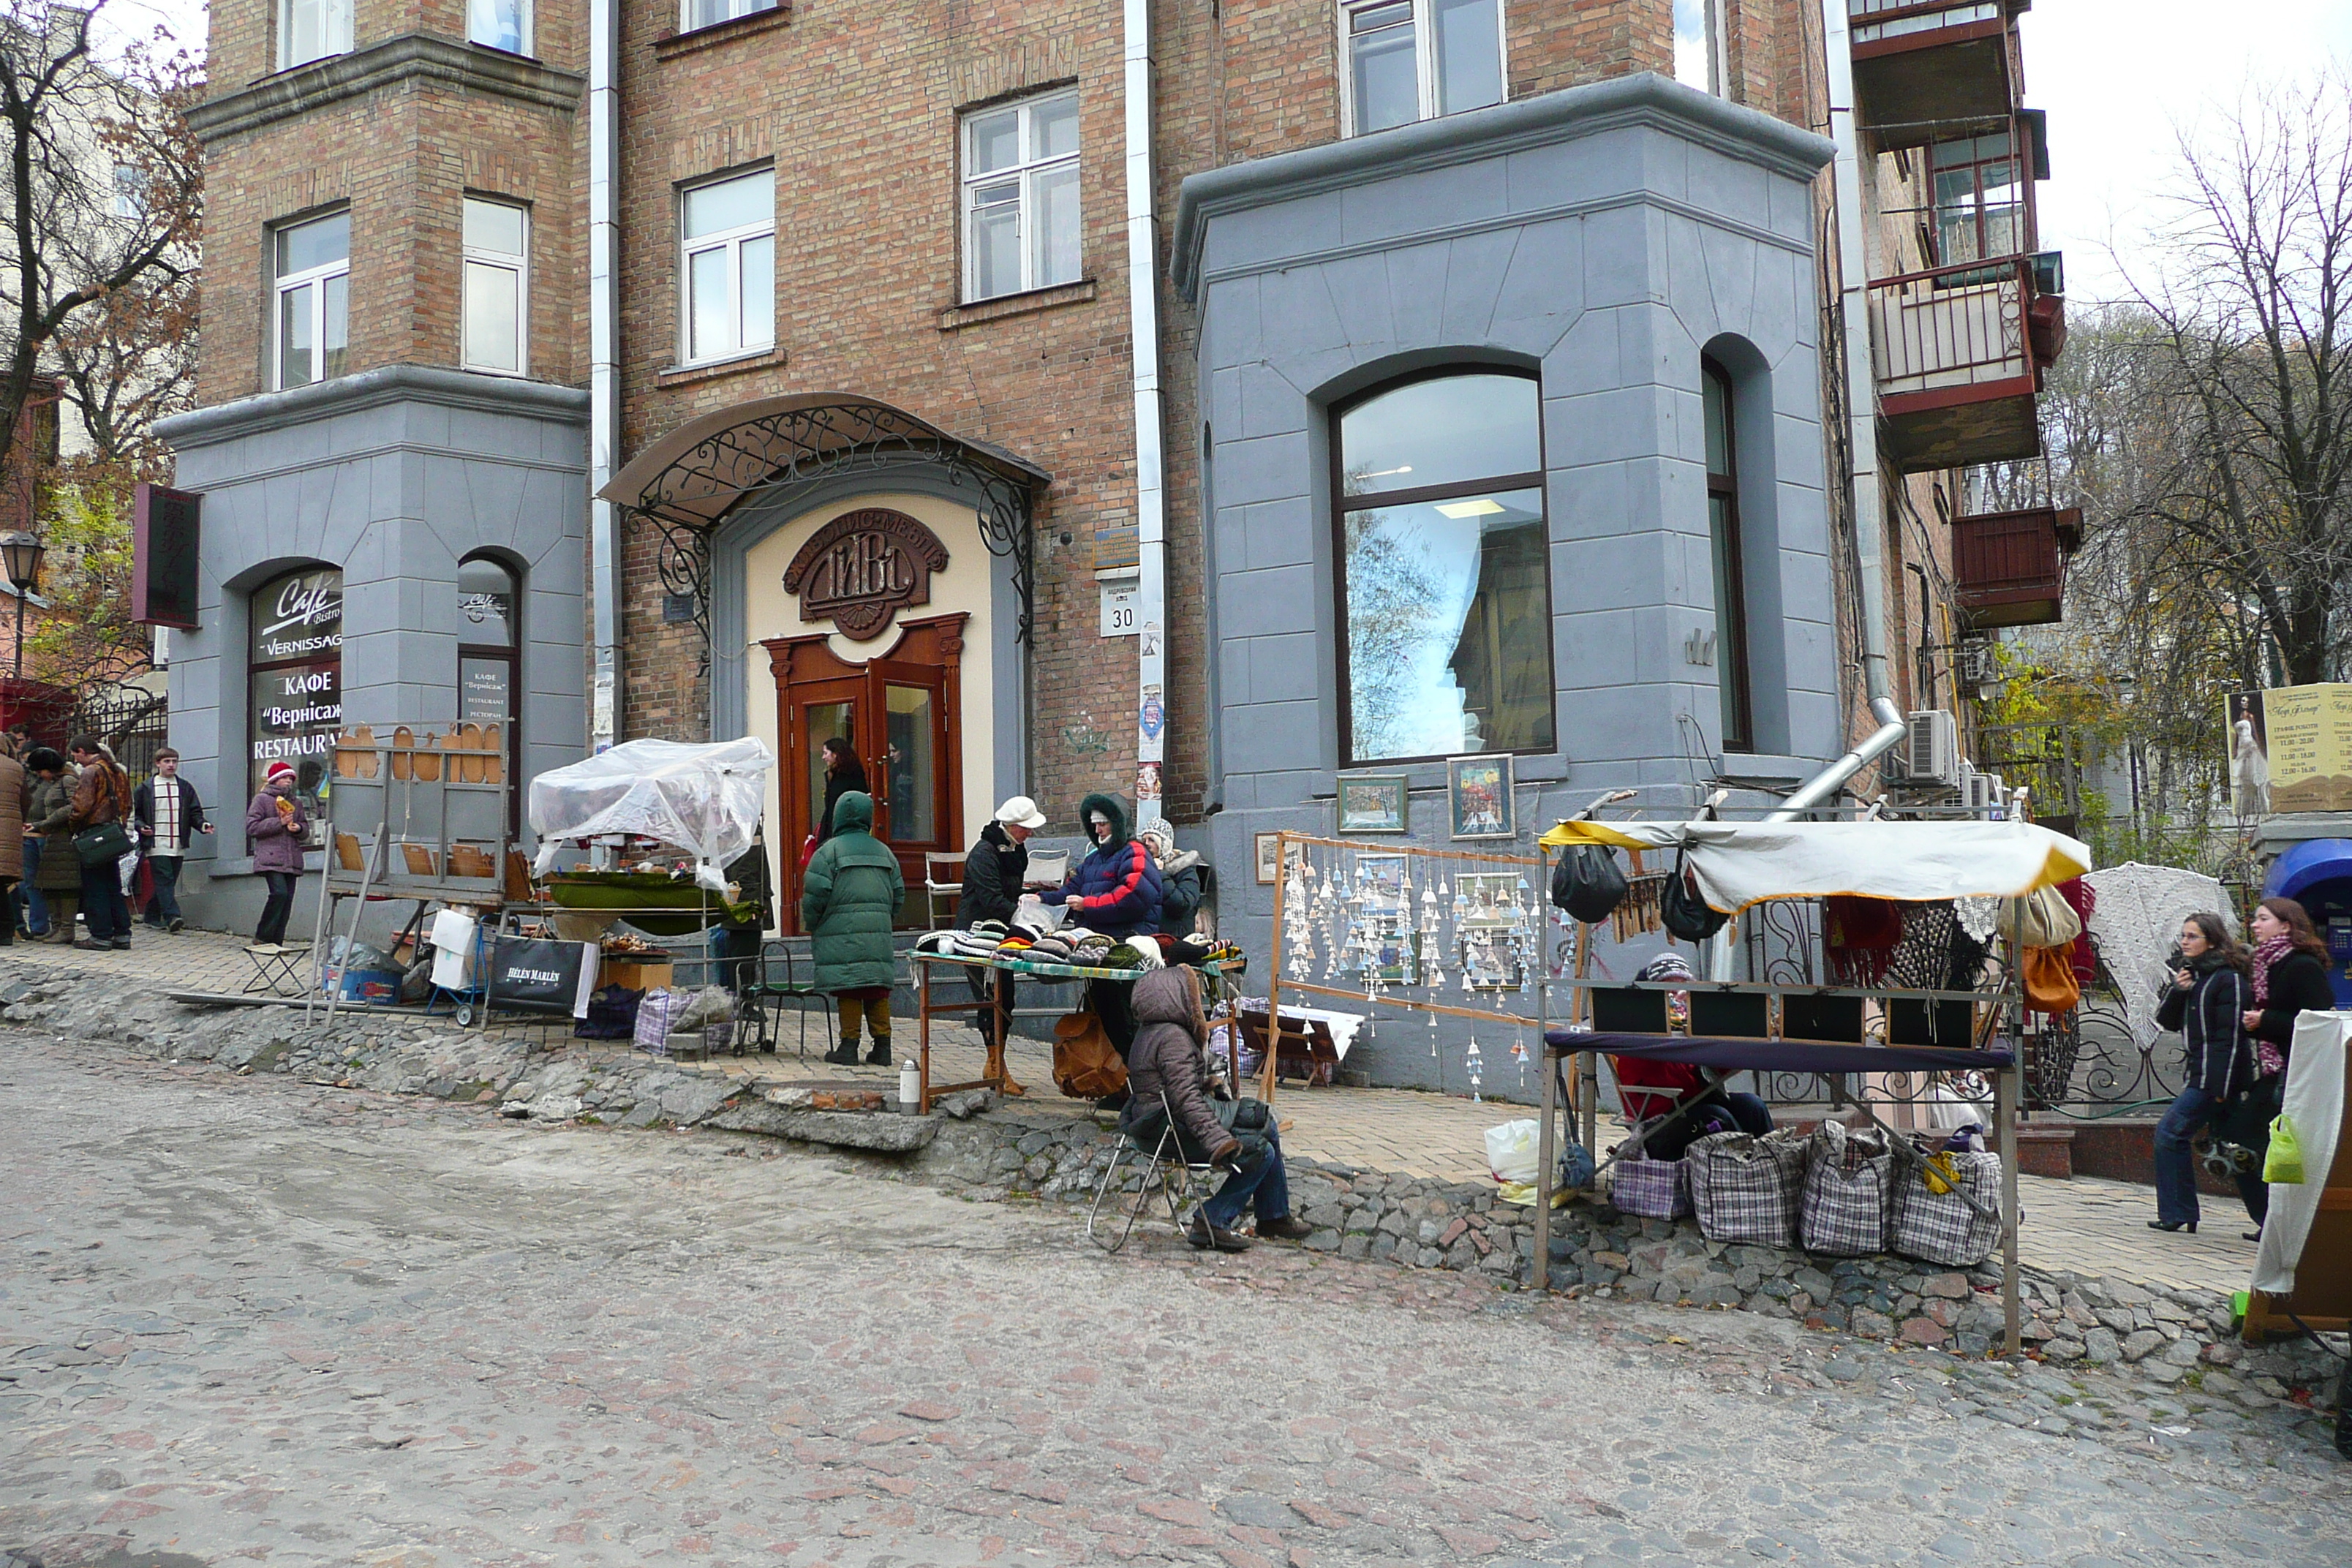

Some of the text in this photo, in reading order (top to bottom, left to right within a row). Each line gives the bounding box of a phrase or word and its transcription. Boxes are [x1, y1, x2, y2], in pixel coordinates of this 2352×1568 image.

[277, 572, 335, 625] Café
[470, 594, 497, 609] Café
[313, 608, 340, 625] Bistro
[1112, 608, 1133, 628] 30
[285, 671, 331, 696] КАФЕ
[475, 673, 497, 681] КАФЕ
[467, 697, 504, 705] RESTAURANT
[255, 732, 342, 760] RESTAURA
[508, 967, 531, 979] HÉLÉN
